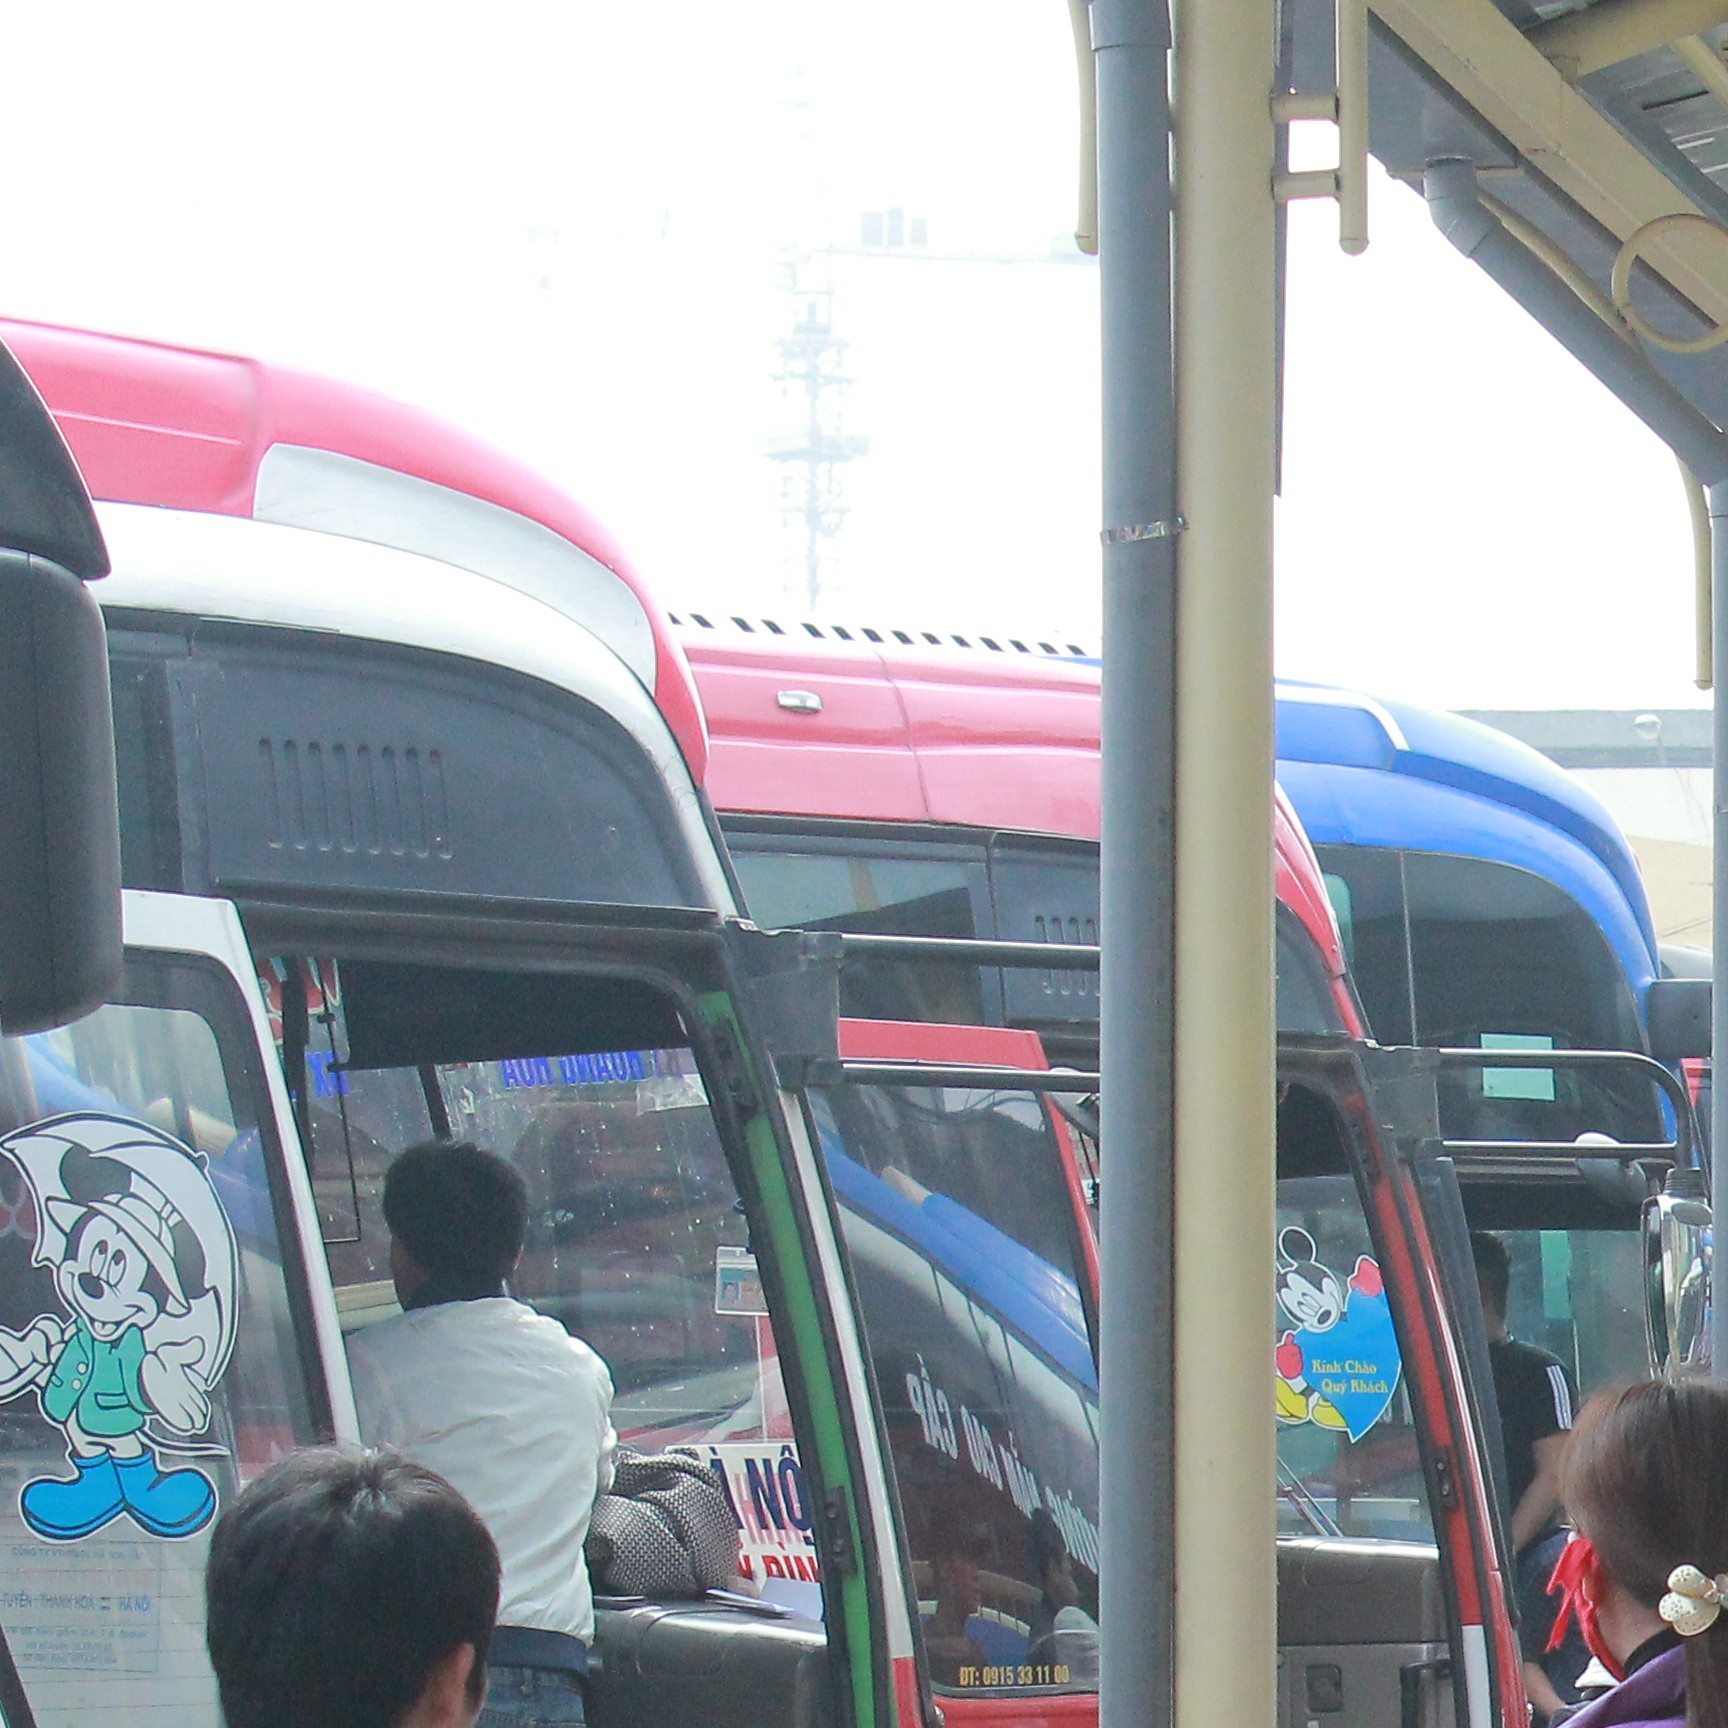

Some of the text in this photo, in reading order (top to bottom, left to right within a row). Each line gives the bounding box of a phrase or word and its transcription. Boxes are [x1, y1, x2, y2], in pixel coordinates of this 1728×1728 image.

[1311, 1359, 1378, 1374] Kính Chào
[1321, 1378, 1389, 1395] Quý Khách
[982, 1666, 1014, 1685] 0915
[1017, 1665, 1033, 1684] 33
[1036, 1665, 1050, 1684] 11
[1054, 1664, 1069, 1684] 00
